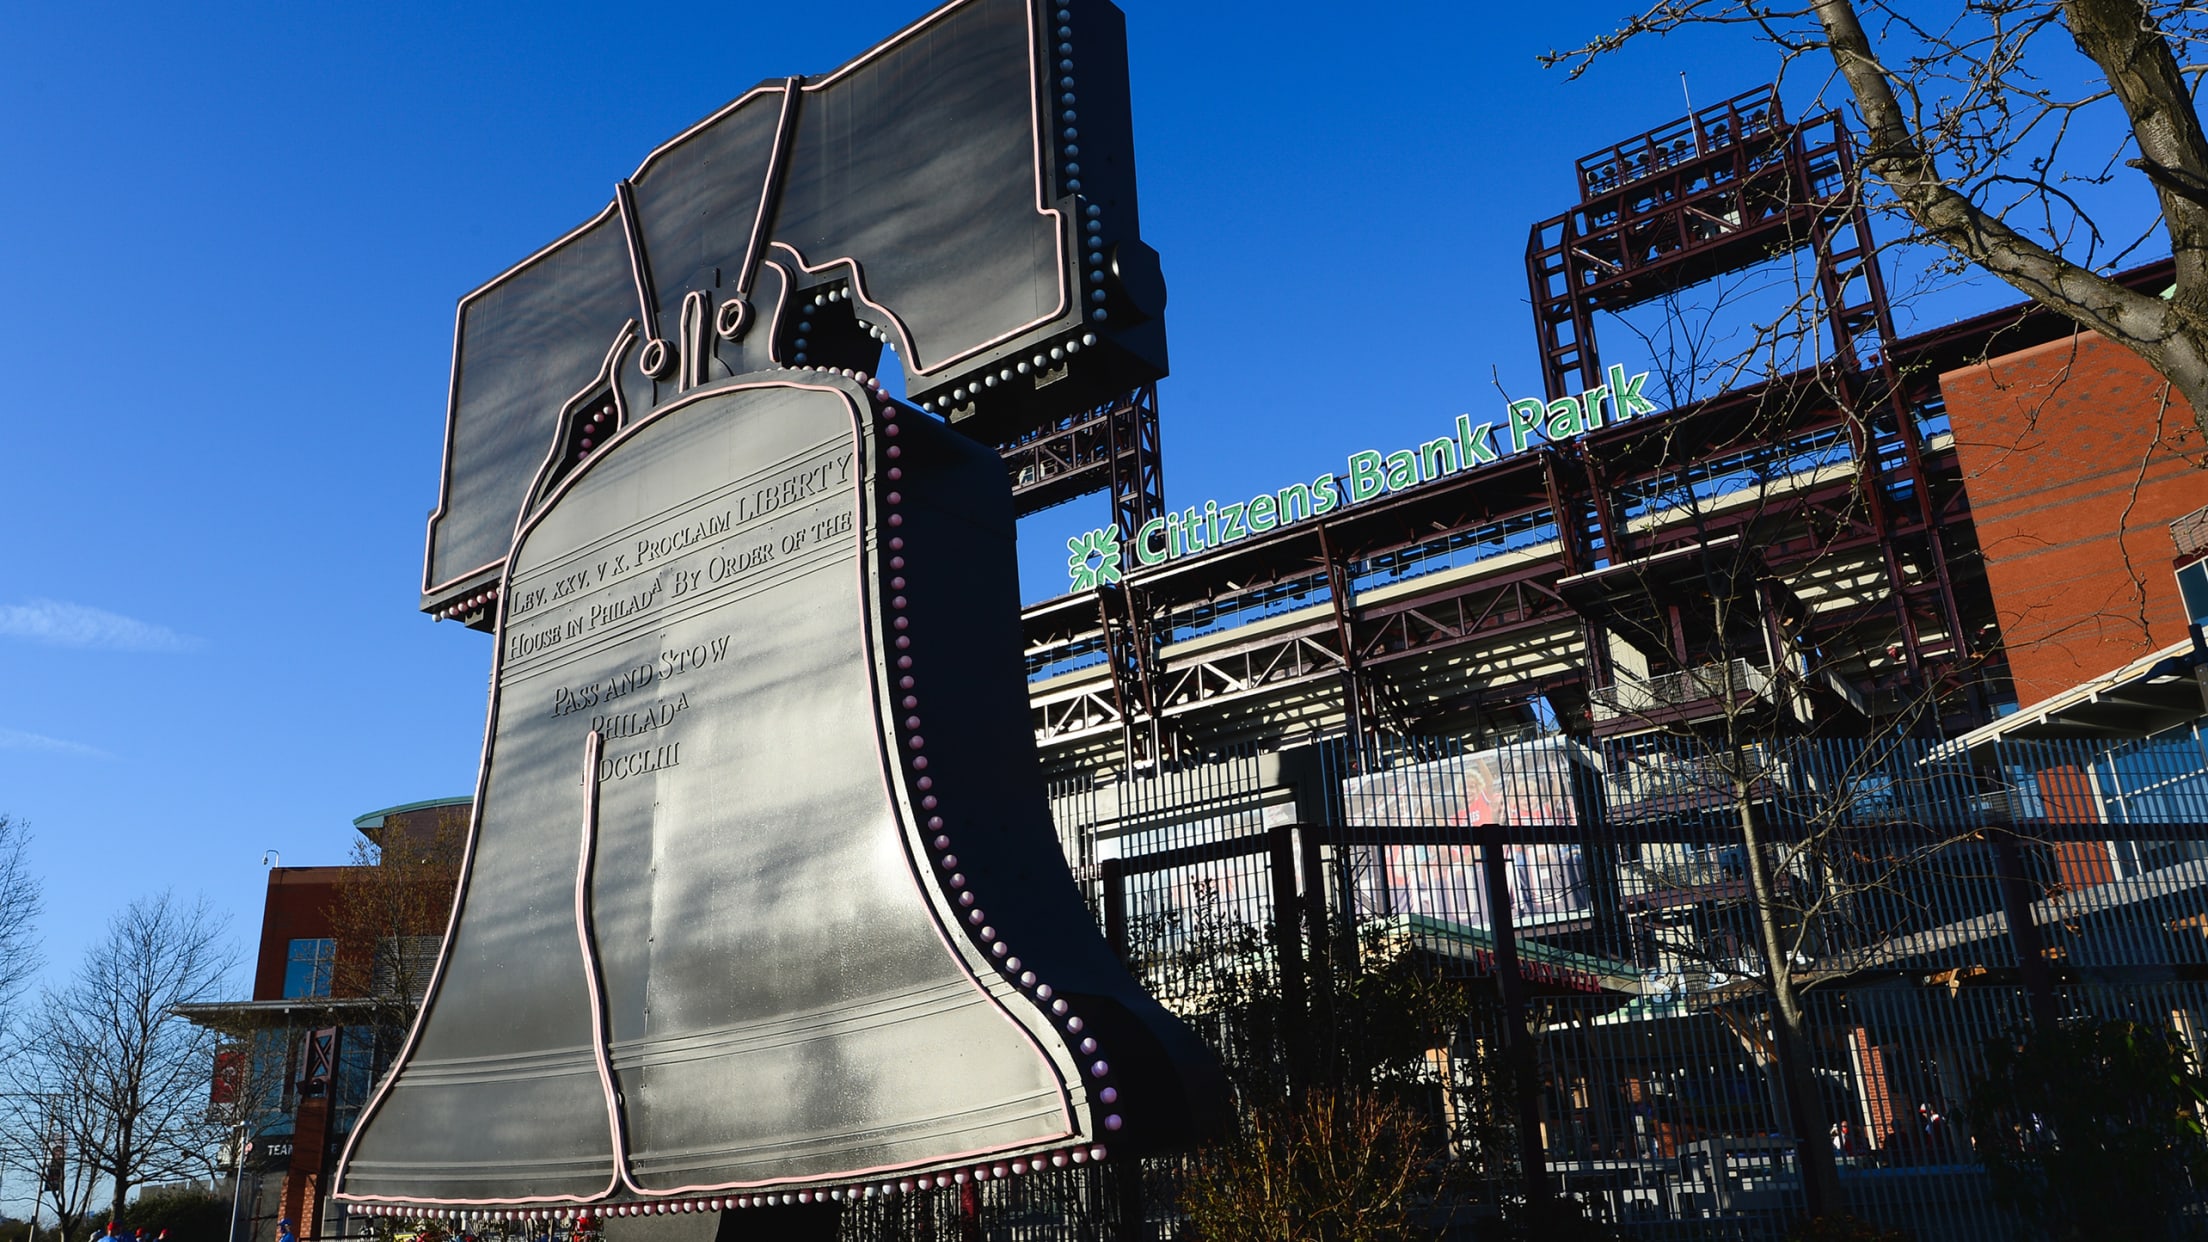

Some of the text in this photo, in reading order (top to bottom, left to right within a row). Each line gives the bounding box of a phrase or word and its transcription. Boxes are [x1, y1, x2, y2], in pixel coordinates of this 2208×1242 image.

[634, 510, 731, 567] PROCLAIM
[735, 452, 854, 527] LIBERTY
[1136, 363, 1657, 566] Citizens Bank Park
[508, 624, 562, 662] HOUSE
[565, 615, 584, 641] IN
[671, 569, 702, 598] BY
[709, 543, 775, 583] ORDER
[781, 529, 806, 555] OF
[811, 511, 852, 544] THE
[551, 635, 731, 718] PASS AND STOW
[580, 742, 680, 786] DCCLIII
